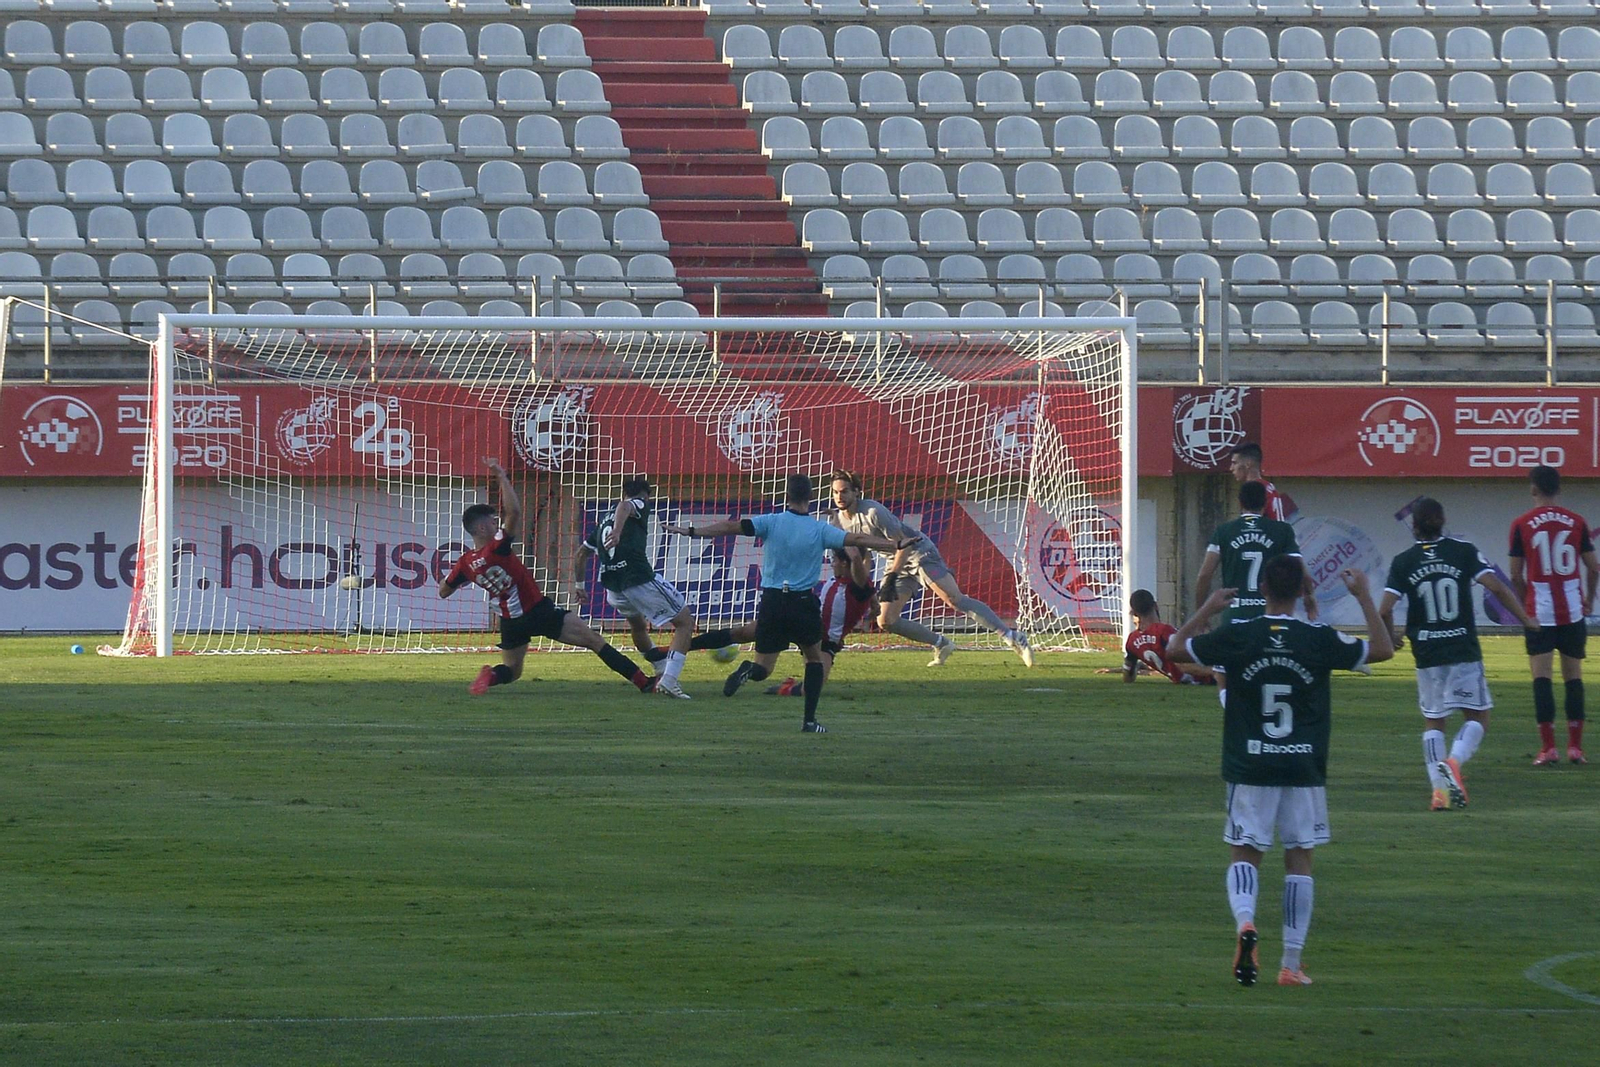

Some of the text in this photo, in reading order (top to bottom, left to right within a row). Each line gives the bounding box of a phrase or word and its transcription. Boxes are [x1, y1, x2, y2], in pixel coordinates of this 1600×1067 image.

[118, 405, 241, 427] PLYOFF
[1469, 446, 1565, 467] 2020
[1307, 543, 1336, 569] Sierra
[1531, 530, 1576, 575] 16
[1241, 552, 1263, 592] 7
[1408, 563, 1462, 586] ALEXANDRE
[1417, 577, 1460, 623] 10
[1262, 684, 1293, 739] 5
